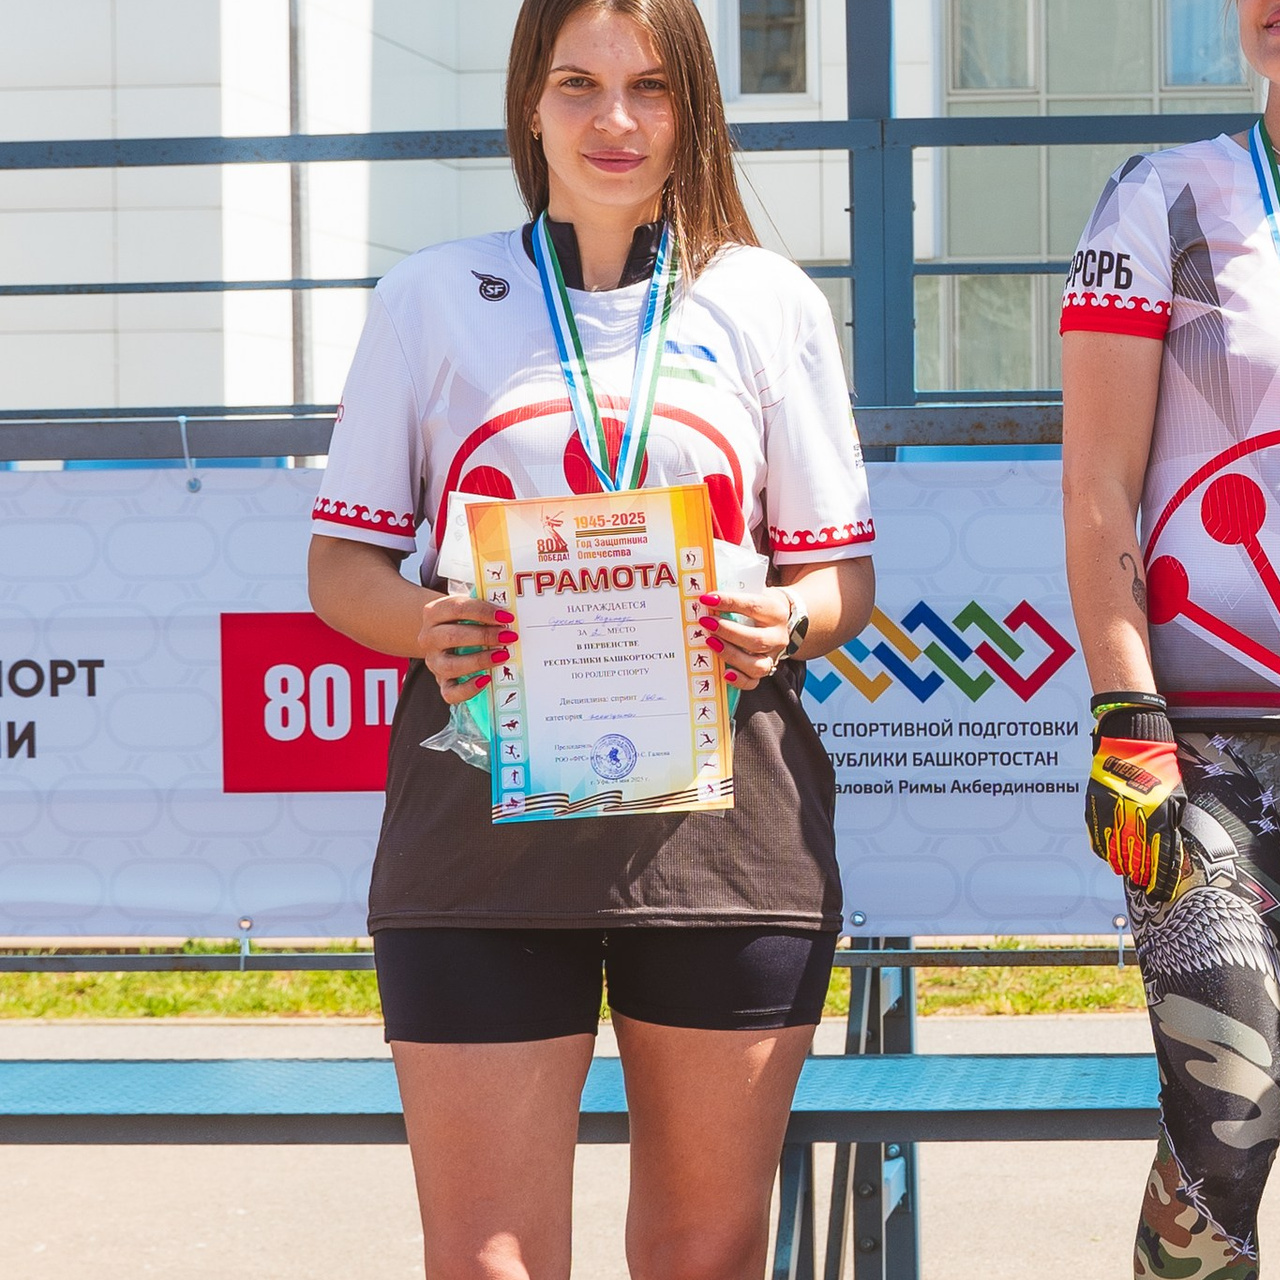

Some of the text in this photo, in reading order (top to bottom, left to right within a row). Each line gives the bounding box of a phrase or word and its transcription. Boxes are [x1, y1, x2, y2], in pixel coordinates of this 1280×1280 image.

[485, 284, 504, 295] SF
[574, 512, 646, 529] 1945-2025
[537, 539, 553, 552] 80
[576, 536, 648, 549] Год Защитника
[538, 553, 570, 563] ПОБЕДА!
[577, 549, 632, 560] Отечества
[514, 562, 678, 597] ГРАМОТА
[567, 601, 646, 614] НАГРАЖДАЕТСЯ
[577, 629, 588, 637] ЗА
[607, 626, 636, 635] МЕСТО
[584, 640, 640, 651] ПЕРВЕНСТВЕ
[543, 652, 676, 667] РЕСПУБЛИКИ БАШКОРТОСТАН
[0, 659, 105, 698] ОРТ
[571, 667, 650, 680] ПО РОЛЛЕР СПОРТУ
[263, 663, 352, 741] 80
[610, 695, 637, 706] спринт
[545, 713, 583, 723] категория
[832, 719, 953, 738] СПОРТИВНОЙ
[959, 721, 1079, 739] ПОДГОТОВКИ
[913, 751, 1059, 767] БАШКОРТОСТАН
[834, 779, 1080, 797] аловой Римы Акбердиновны
